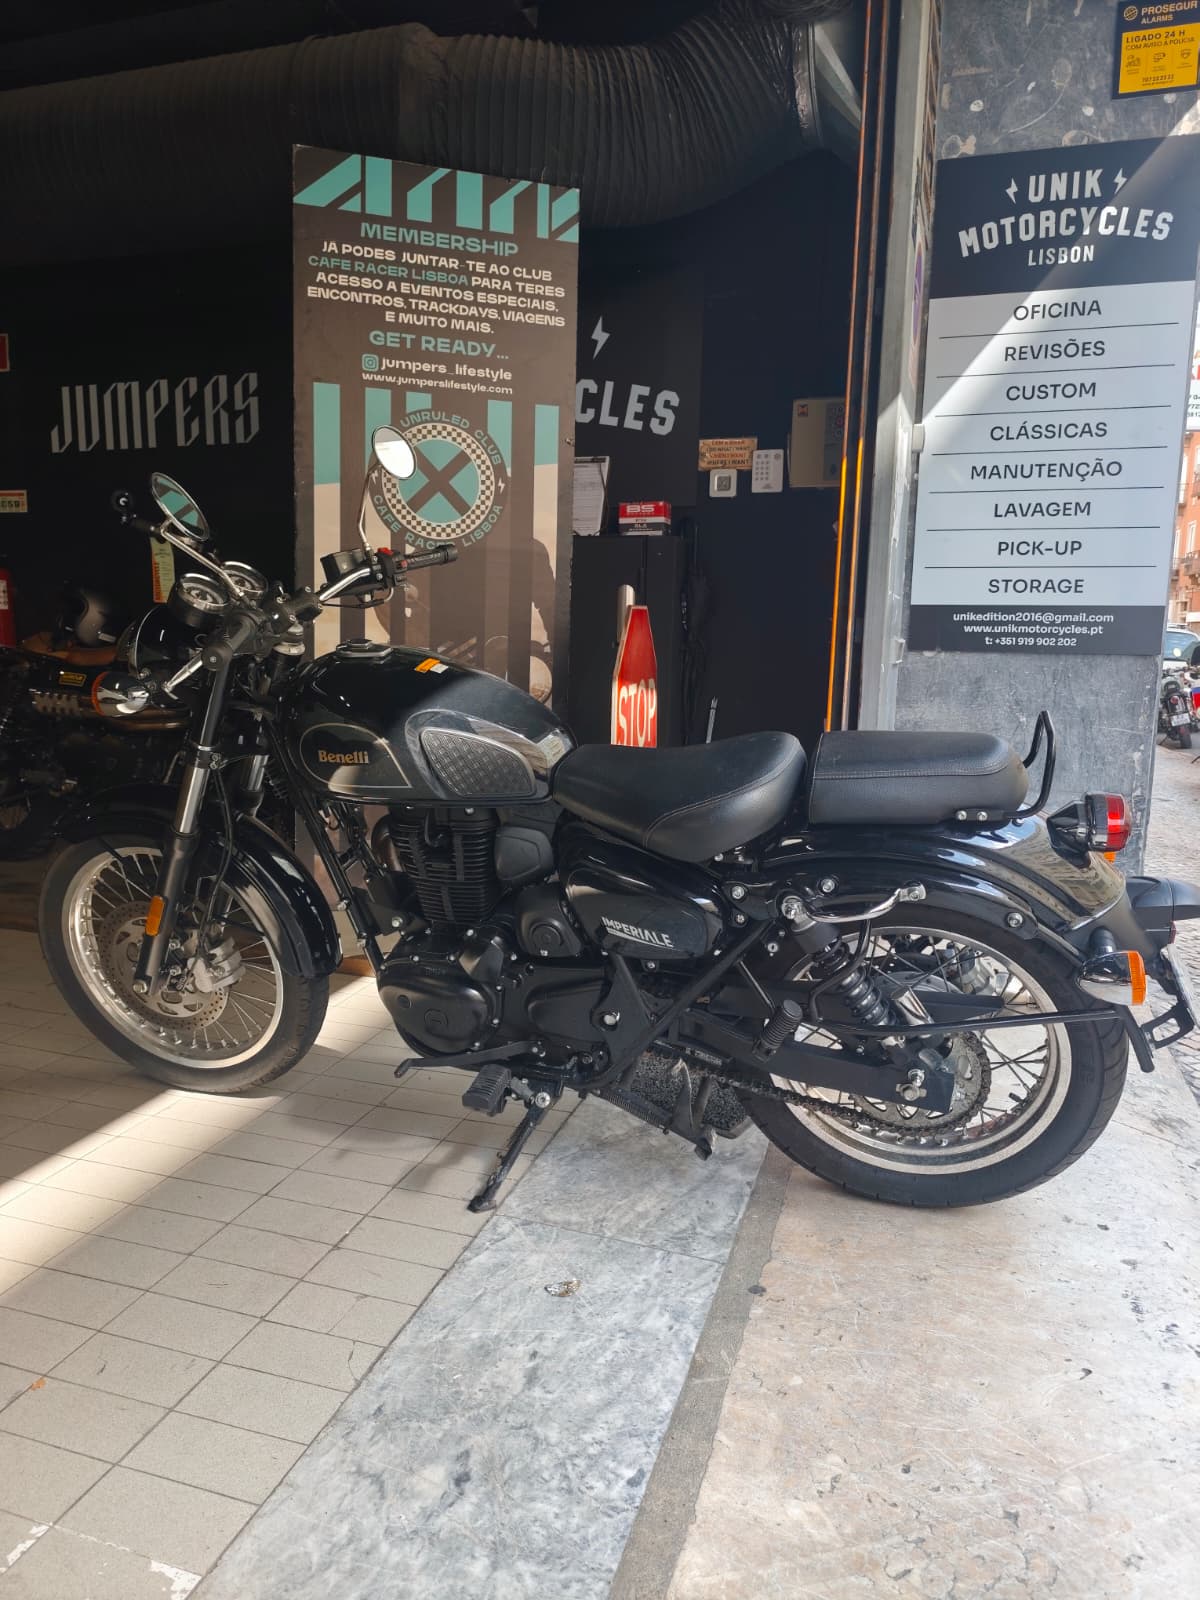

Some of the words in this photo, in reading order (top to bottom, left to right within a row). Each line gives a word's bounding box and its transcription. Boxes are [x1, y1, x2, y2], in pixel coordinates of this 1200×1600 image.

[1141, 1, 1198, 16] PROSEGUR
[1141, 14, 1174, 24] ALARMS
[1126, 33, 1162, 44] LIGADO
[1165, 31, 1176, 39] 24
[1028, 168, 1103, 203] UNIK
[360, 222, 519, 256] MEMBERSHIP
[958, 206, 1174, 257] MOTORCYCLES
[342, 244, 396, 261] PODES
[488, 264, 510, 275] AO
[513, 267, 552, 281] CLUB
[1028, 244, 1095, 266] LISBON
[308, 256, 351, 270] CAFE
[354, 261, 408, 278] RACER
[412, 268, 468, 286] LISBOA
[471, 276, 512, 291] PARA
[515, 282, 565, 298] TERES
[316, 272, 383, 290] ACESSO
[386, 281, 398, 292] A
[400, 282, 474, 301] EVENTOS
[502, 310, 566, 327] VIAGENS
[1013, 300, 1102, 321] OFICINA
[385, 311, 396, 322] E
[398, 313, 448, 328] MUITO
[450, 318, 494, 334] MAIS.
[369, 330, 416, 349] GET
[1004, 338, 1106, 362] REVISÕES
[381, 357, 512, 382] jumpers_lifestyle
[362, 372, 513, 394] www.jumperslifestyle.com
[1006, 382, 1097, 401] CUSTOM
[51, 372, 260, 453] JUMPERS
[400, 410, 470, 429] UNRULED
[474, 430, 502, 465] CLUB
[990, 421, 1108, 441] CLÁSSICAS
[970, 458, 1122, 482] MANUTENÇÃO
[626, 504, 656, 512] BS
[994, 502, 1092, 518] LAVAGEM
[373, 495, 402, 533] CAFE
[462, 504, 504, 547] LISBOA
[998, 541, 1082, 556] PICK-UP
[988, 579, 1085, 594] STORAGE
[953, 612, 1114, 624] unikedition2016@gmail.com
[964, 624, 1104, 636] www.unikmotorcycles.pt
[985, 636, 993, 645] t:
[994, 637, 1016, 646] +351
[1018, 637, 1034, 646] 919
[1036, 638, 1056, 646] 902
[1058, 638, 1076, 646] 202
[618, 678, 657, 746] STOP
[318, 750, 369, 764] Benelli
[602, 916, 674, 948] IMPERIALE
